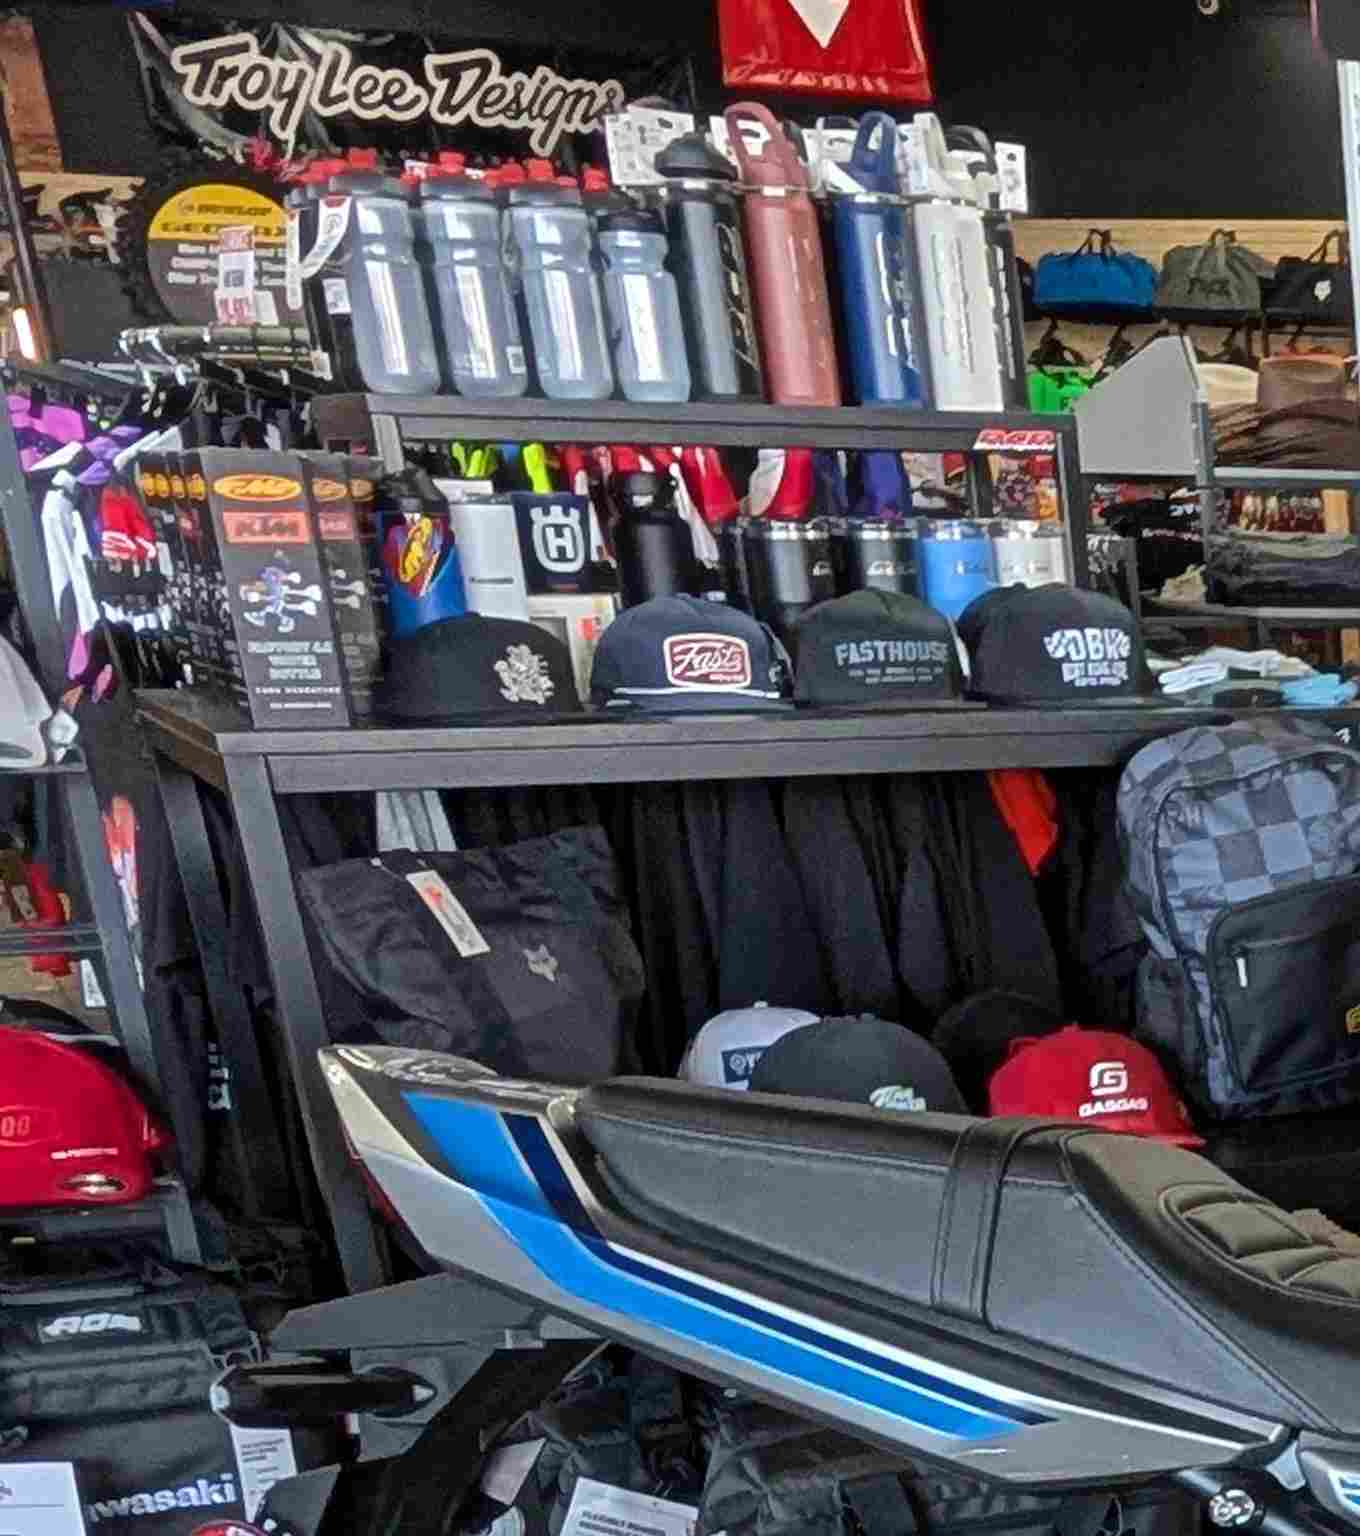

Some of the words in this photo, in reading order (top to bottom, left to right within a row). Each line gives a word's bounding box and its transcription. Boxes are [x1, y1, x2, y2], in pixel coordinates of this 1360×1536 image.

[171, 33, 312, 139] Troy
[311, 42, 428, 121] Lee
[424, 48, 623, 156] Designs
[834, 640, 948, 667] FASTHOUSE
[1079, 1097, 1148, 1118] GASGAS
[84, 1473, 236, 1522] wasaki
